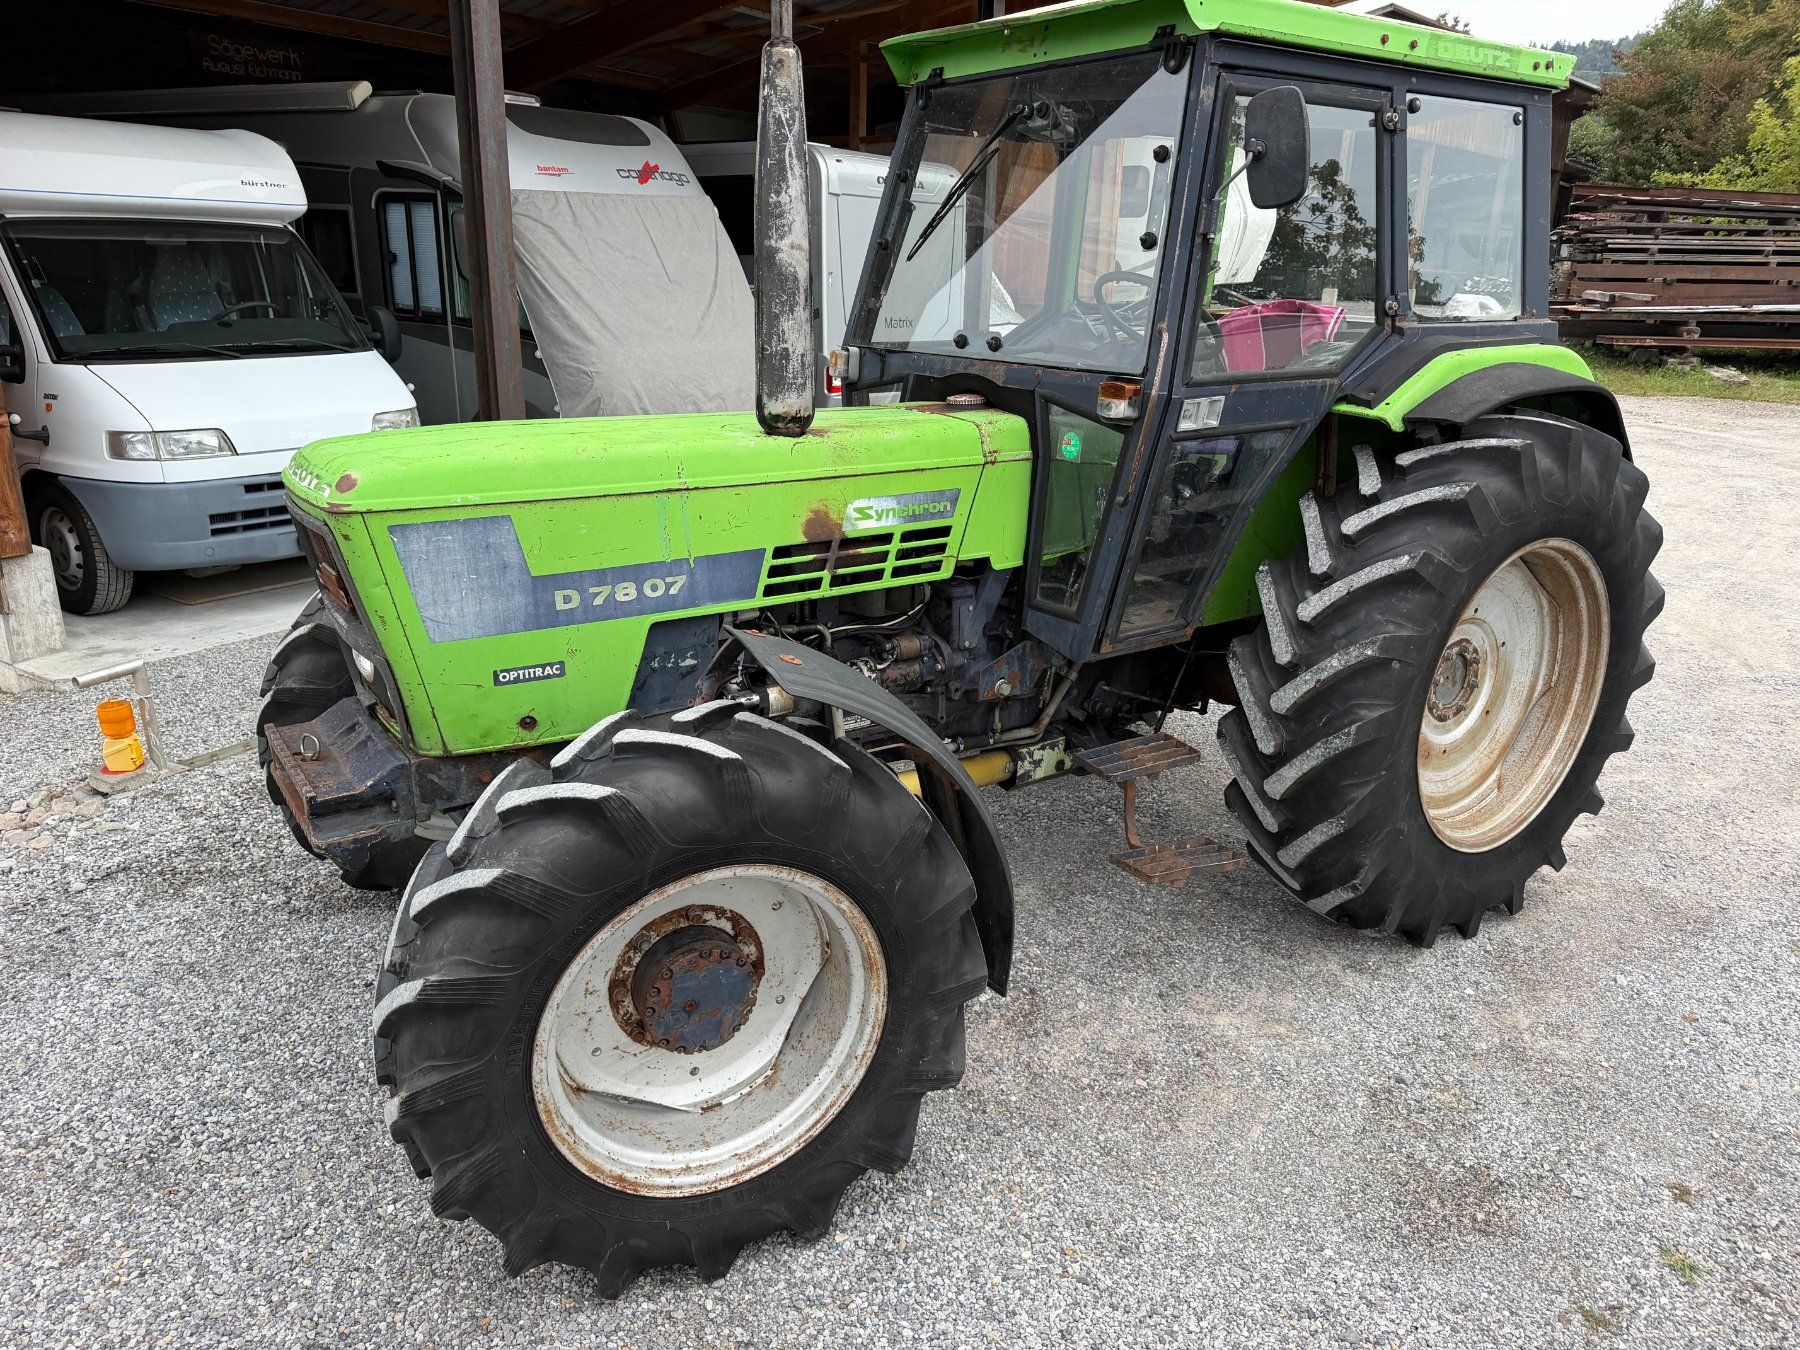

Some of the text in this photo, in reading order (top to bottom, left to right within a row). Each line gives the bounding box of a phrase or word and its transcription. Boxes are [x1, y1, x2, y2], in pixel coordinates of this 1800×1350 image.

[1437, 41, 1511, 68] DEUTZ
[536, 164, 570, 174] bantam
[240, 179, 286, 188] bürstner
[884, 316, 914, 329] Matrix
[852, 501, 951, 522] Synchron
[554, 589, 581, 611] D
[499, 664, 561, 683] OPTITRAC
